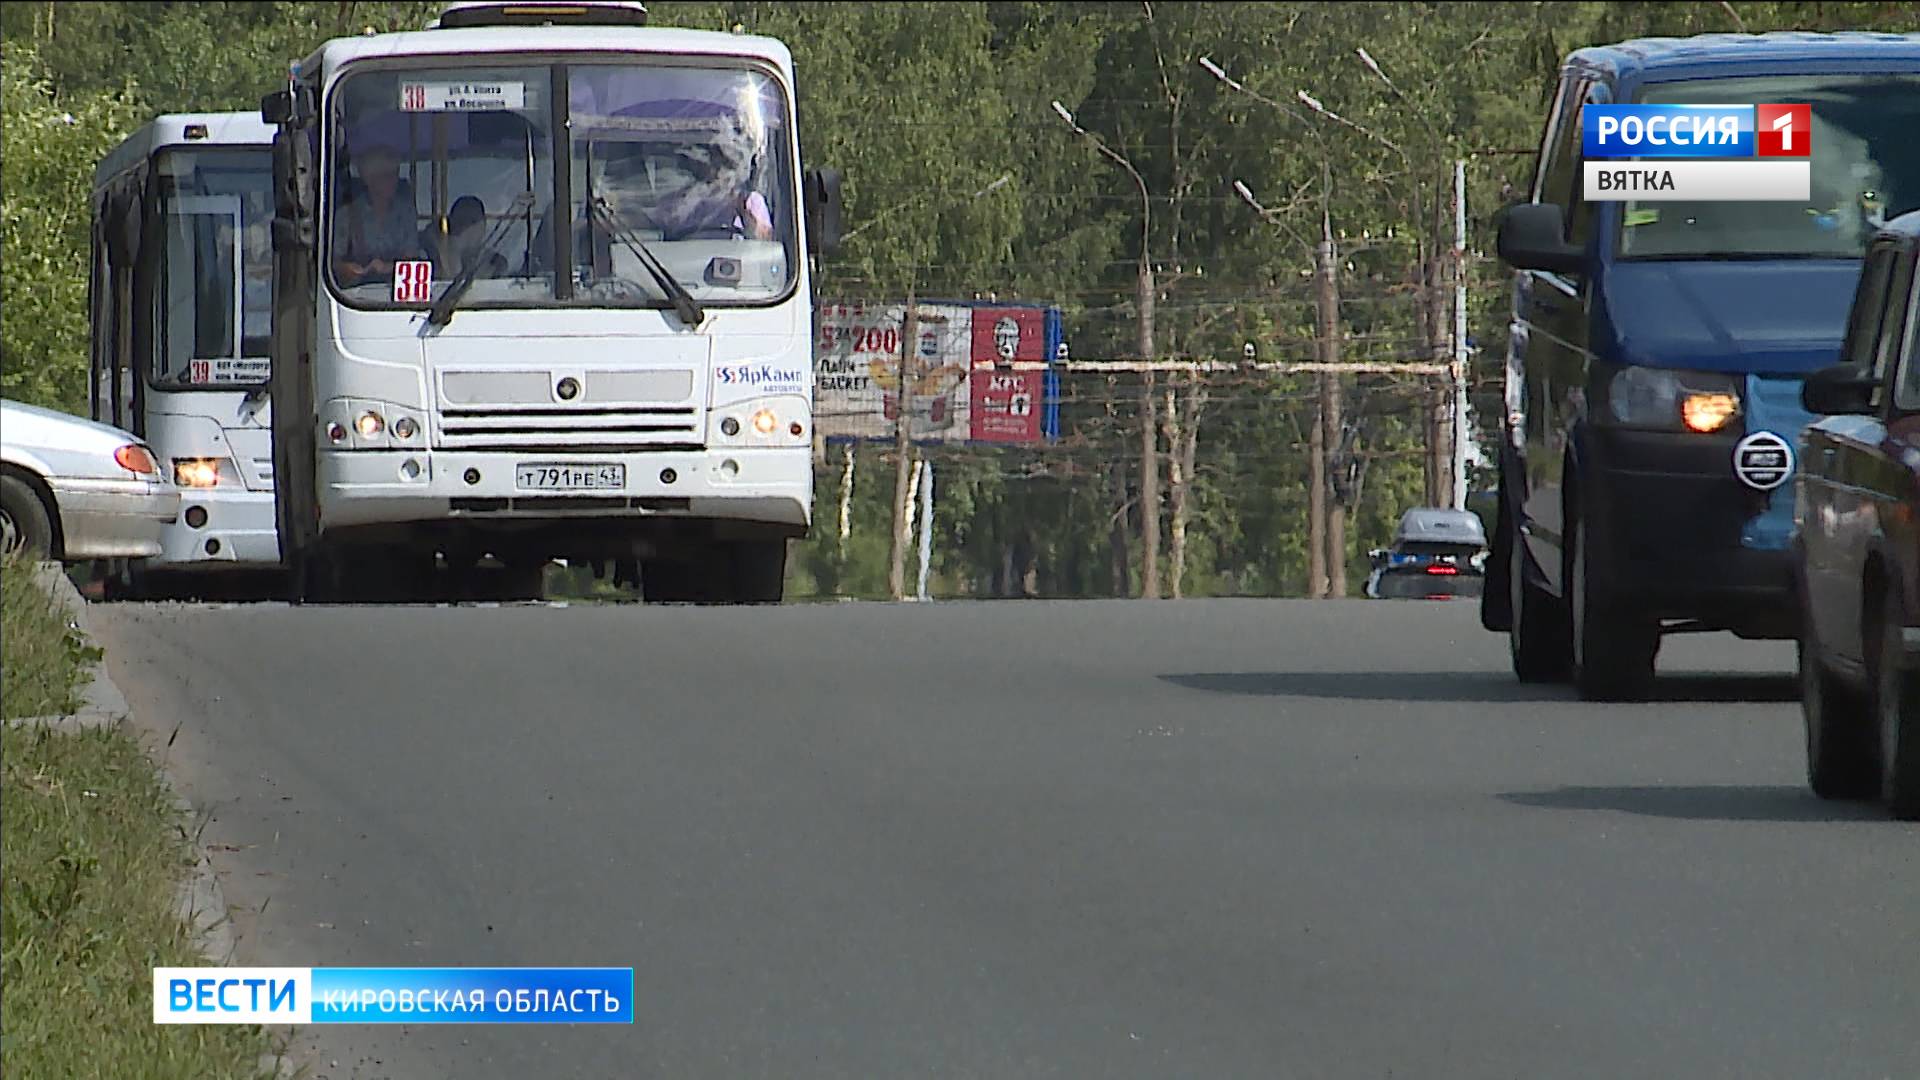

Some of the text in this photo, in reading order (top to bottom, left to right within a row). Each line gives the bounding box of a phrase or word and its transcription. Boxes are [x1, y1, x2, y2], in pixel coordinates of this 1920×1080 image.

[404, 84, 425, 109] 38
[397, 262, 429, 301] 38
[852, 324, 897, 354] 200
[192, 361, 209, 383] 39
[525, 468, 595, 486] Т791РЕ
